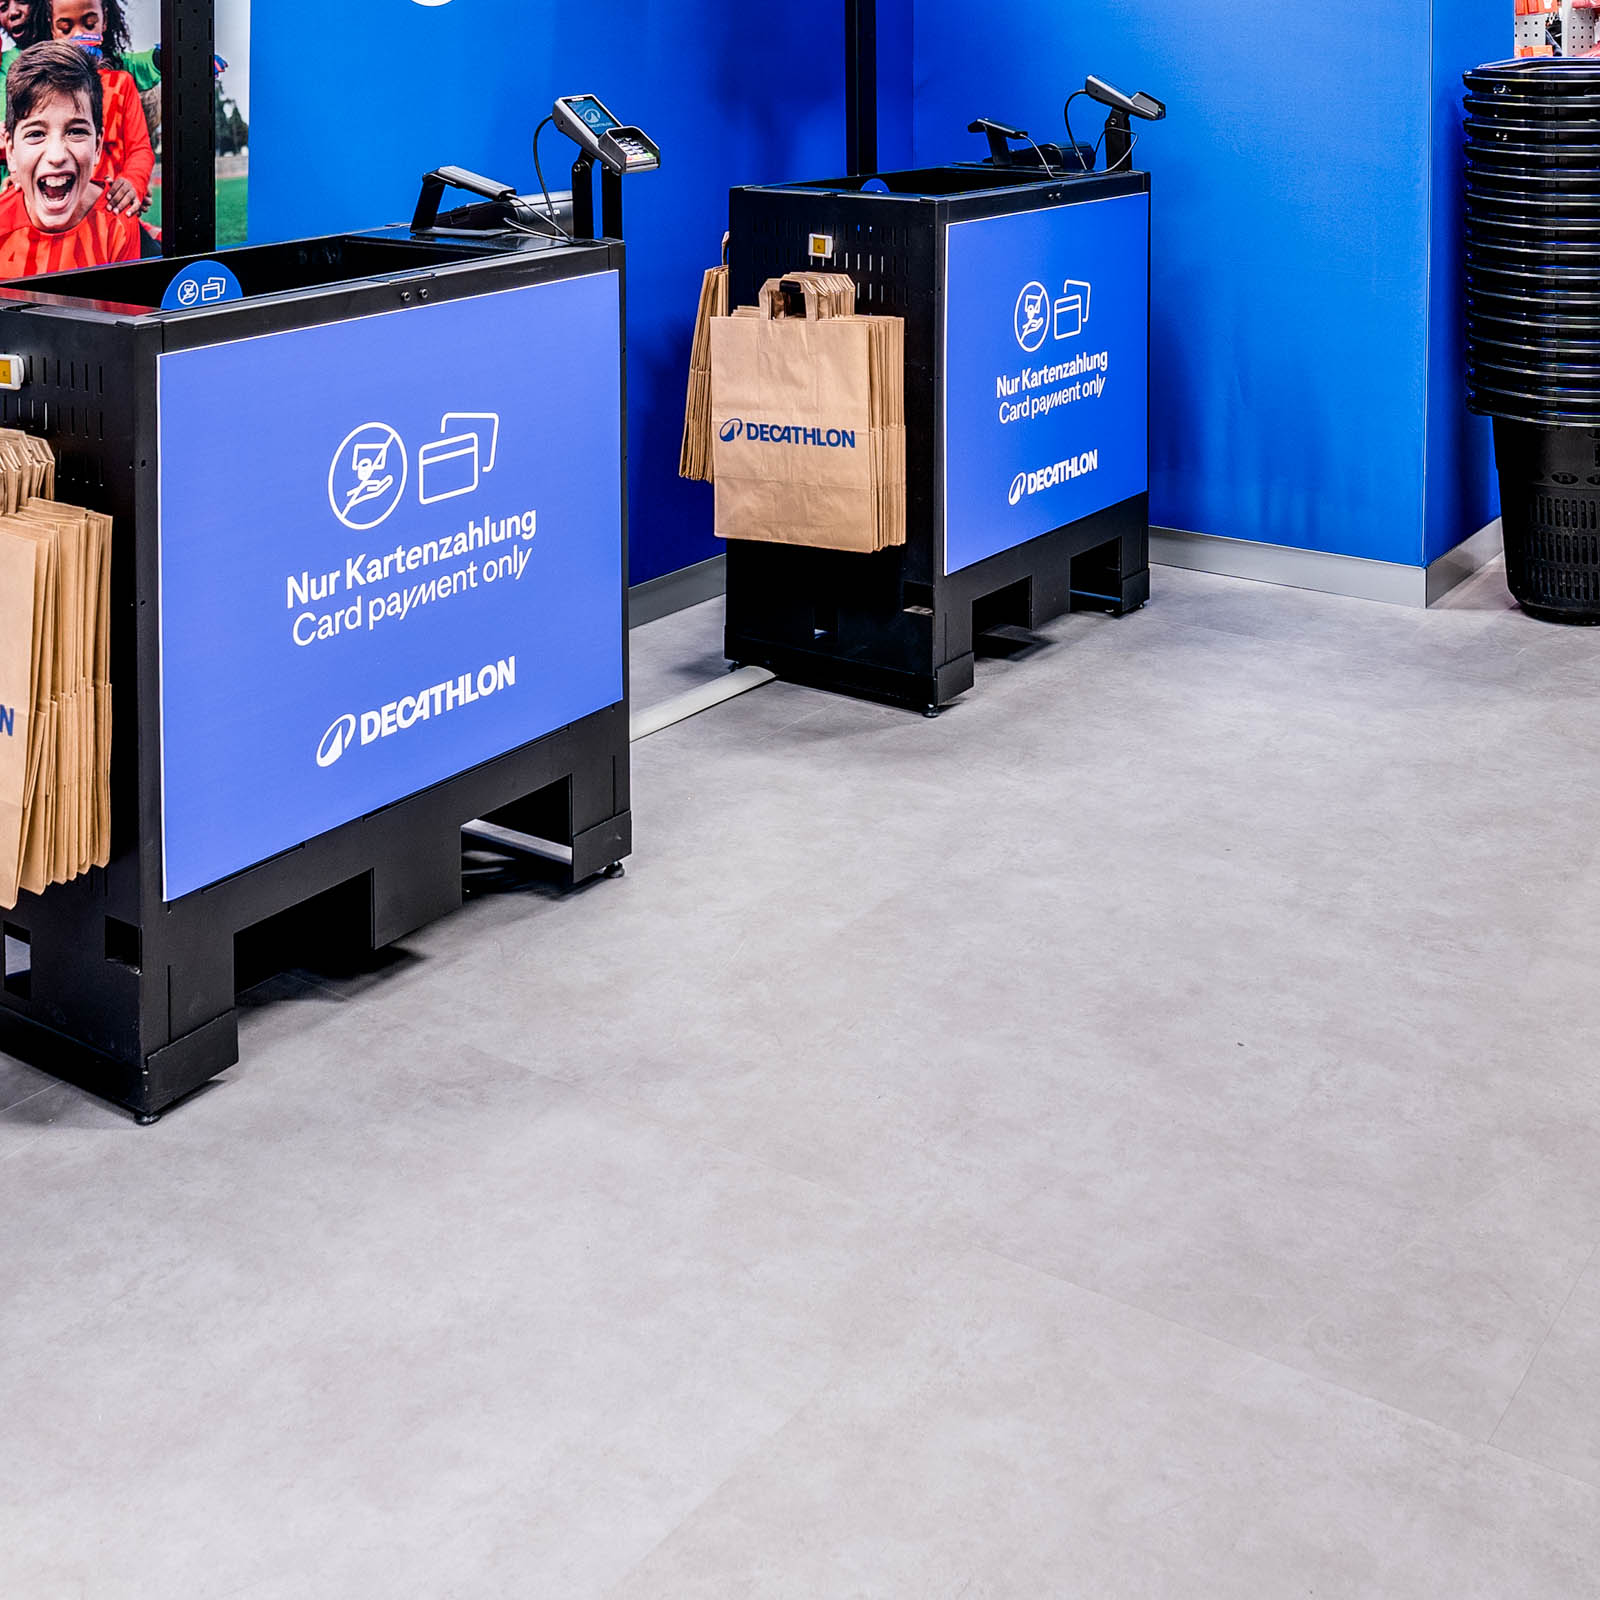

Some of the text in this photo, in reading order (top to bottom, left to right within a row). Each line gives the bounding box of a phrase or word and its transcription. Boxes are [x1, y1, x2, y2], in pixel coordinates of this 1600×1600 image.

[996, 352, 1107, 399] Nur Kartenzahlung
[999, 375, 1107, 424] Card payment only
[745, 422, 856, 449] DECATHLON
[1028, 449, 1097, 494] DECATHLON
[288, 510, 536, 608] Nur Kartenzahlung
[293, 545, 532, 646] Card payment only
[361, 656, 515, 745] DECATHLON
